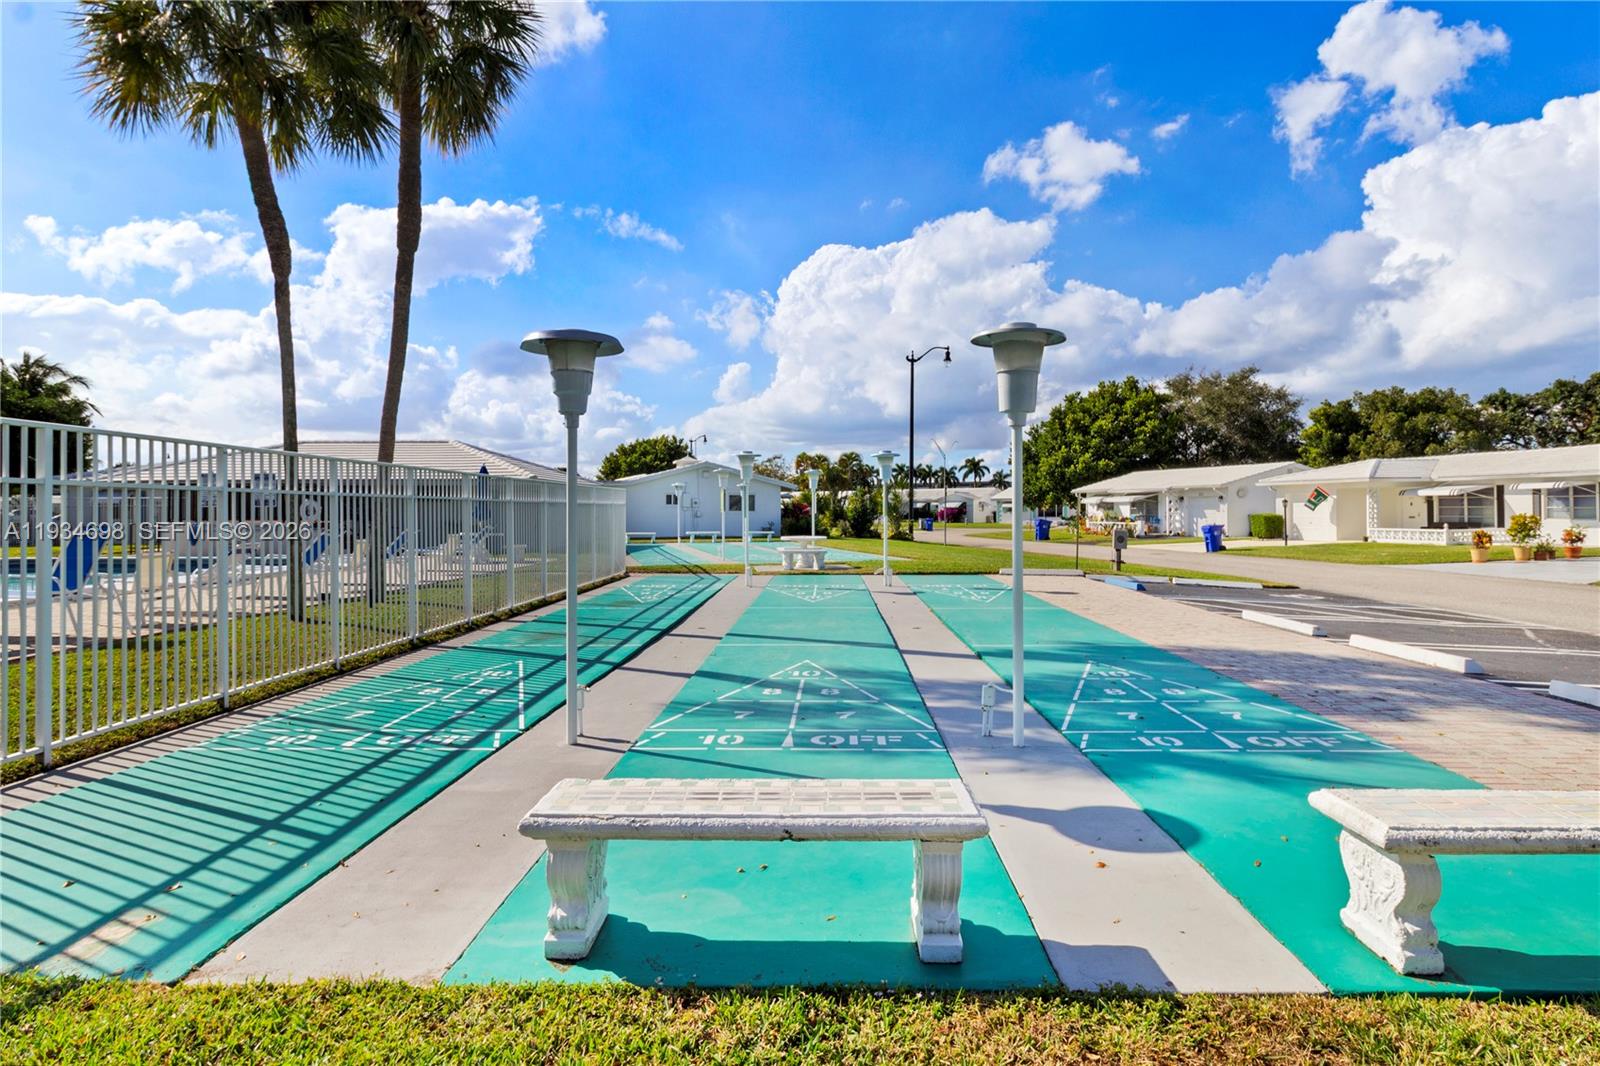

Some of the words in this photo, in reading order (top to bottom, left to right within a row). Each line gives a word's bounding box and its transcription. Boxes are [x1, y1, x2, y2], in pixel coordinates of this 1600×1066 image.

[761, 687, 783, 696] 8
[819, 687, 841, 696] 8
[1103, 687, 1127, 696] 8
[1161, 687, 1187, 696] 8
[733, 710, 755, 720] 7
[834, 710, 857, 720] 7
[1116, 710, 1138, 721] 7
[1219, 710, 1243, 720] 7
[698, 733, 745, 745] 10
[810, 735, 903, 746] OFF
[1130, 735, 1184, 747] 10
[1246, 735, 1343, 747] OFF
